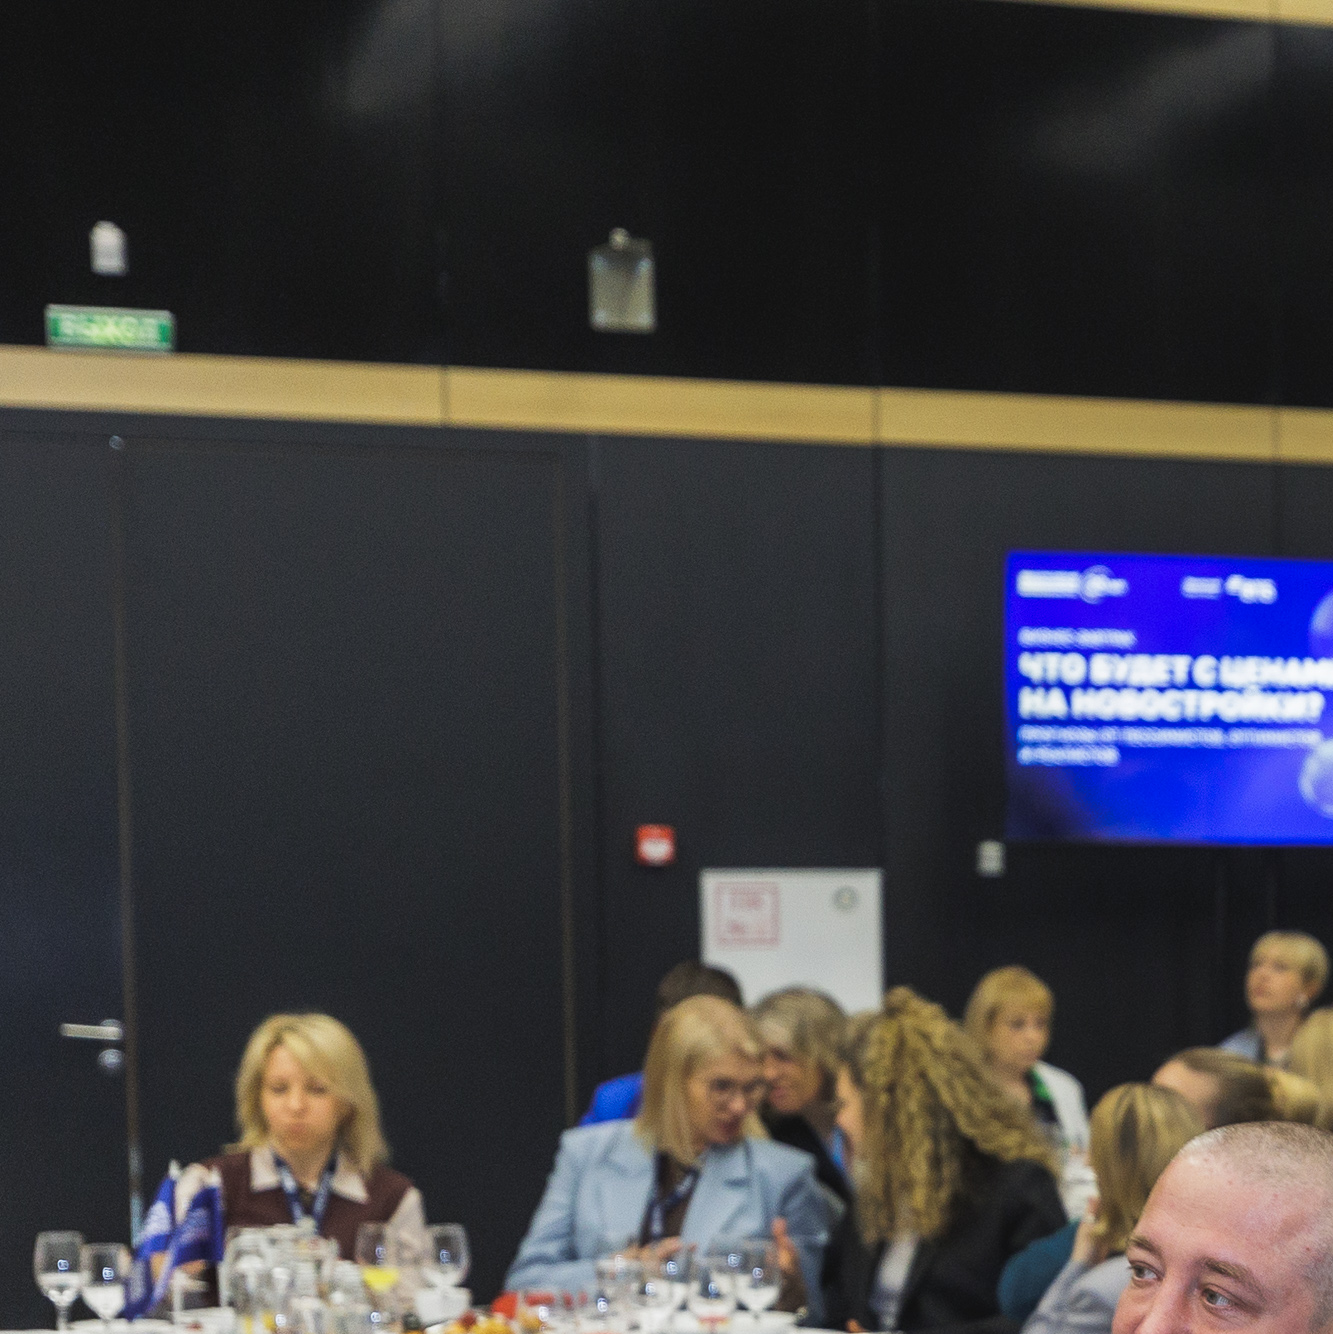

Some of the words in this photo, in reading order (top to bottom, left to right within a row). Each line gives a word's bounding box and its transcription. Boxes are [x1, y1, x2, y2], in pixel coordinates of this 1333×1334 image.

[1017, 652, 1087, 686] ЧТО
[1089, 653, 1192, 688] БУДЕТ
[1193, 655, 1219, 688] С
[1018, 686, 1069, 720] НА
[1071, 686, 1325, 723] НОВОСТРОЙКИ?
